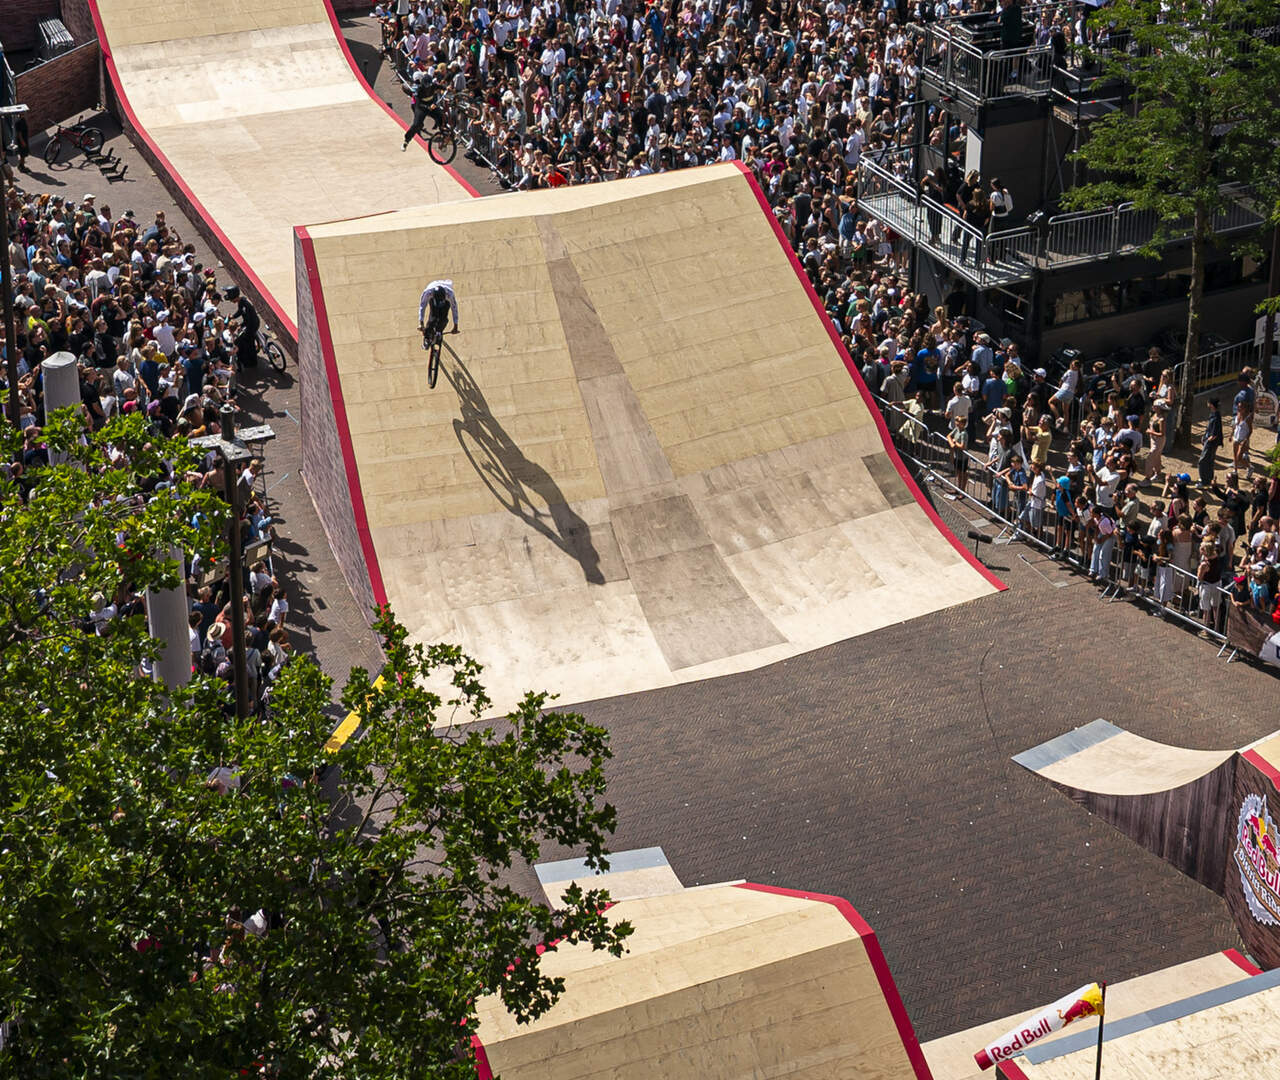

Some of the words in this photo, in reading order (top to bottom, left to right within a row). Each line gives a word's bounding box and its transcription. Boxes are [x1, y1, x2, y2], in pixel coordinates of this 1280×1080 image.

[1241, 824, 1261, 867] Red
[1240, 848, 1261, 894] District
[990, 1034, 1023, 1062] Red
[1021, 1017, 1052, 1046] Bull
